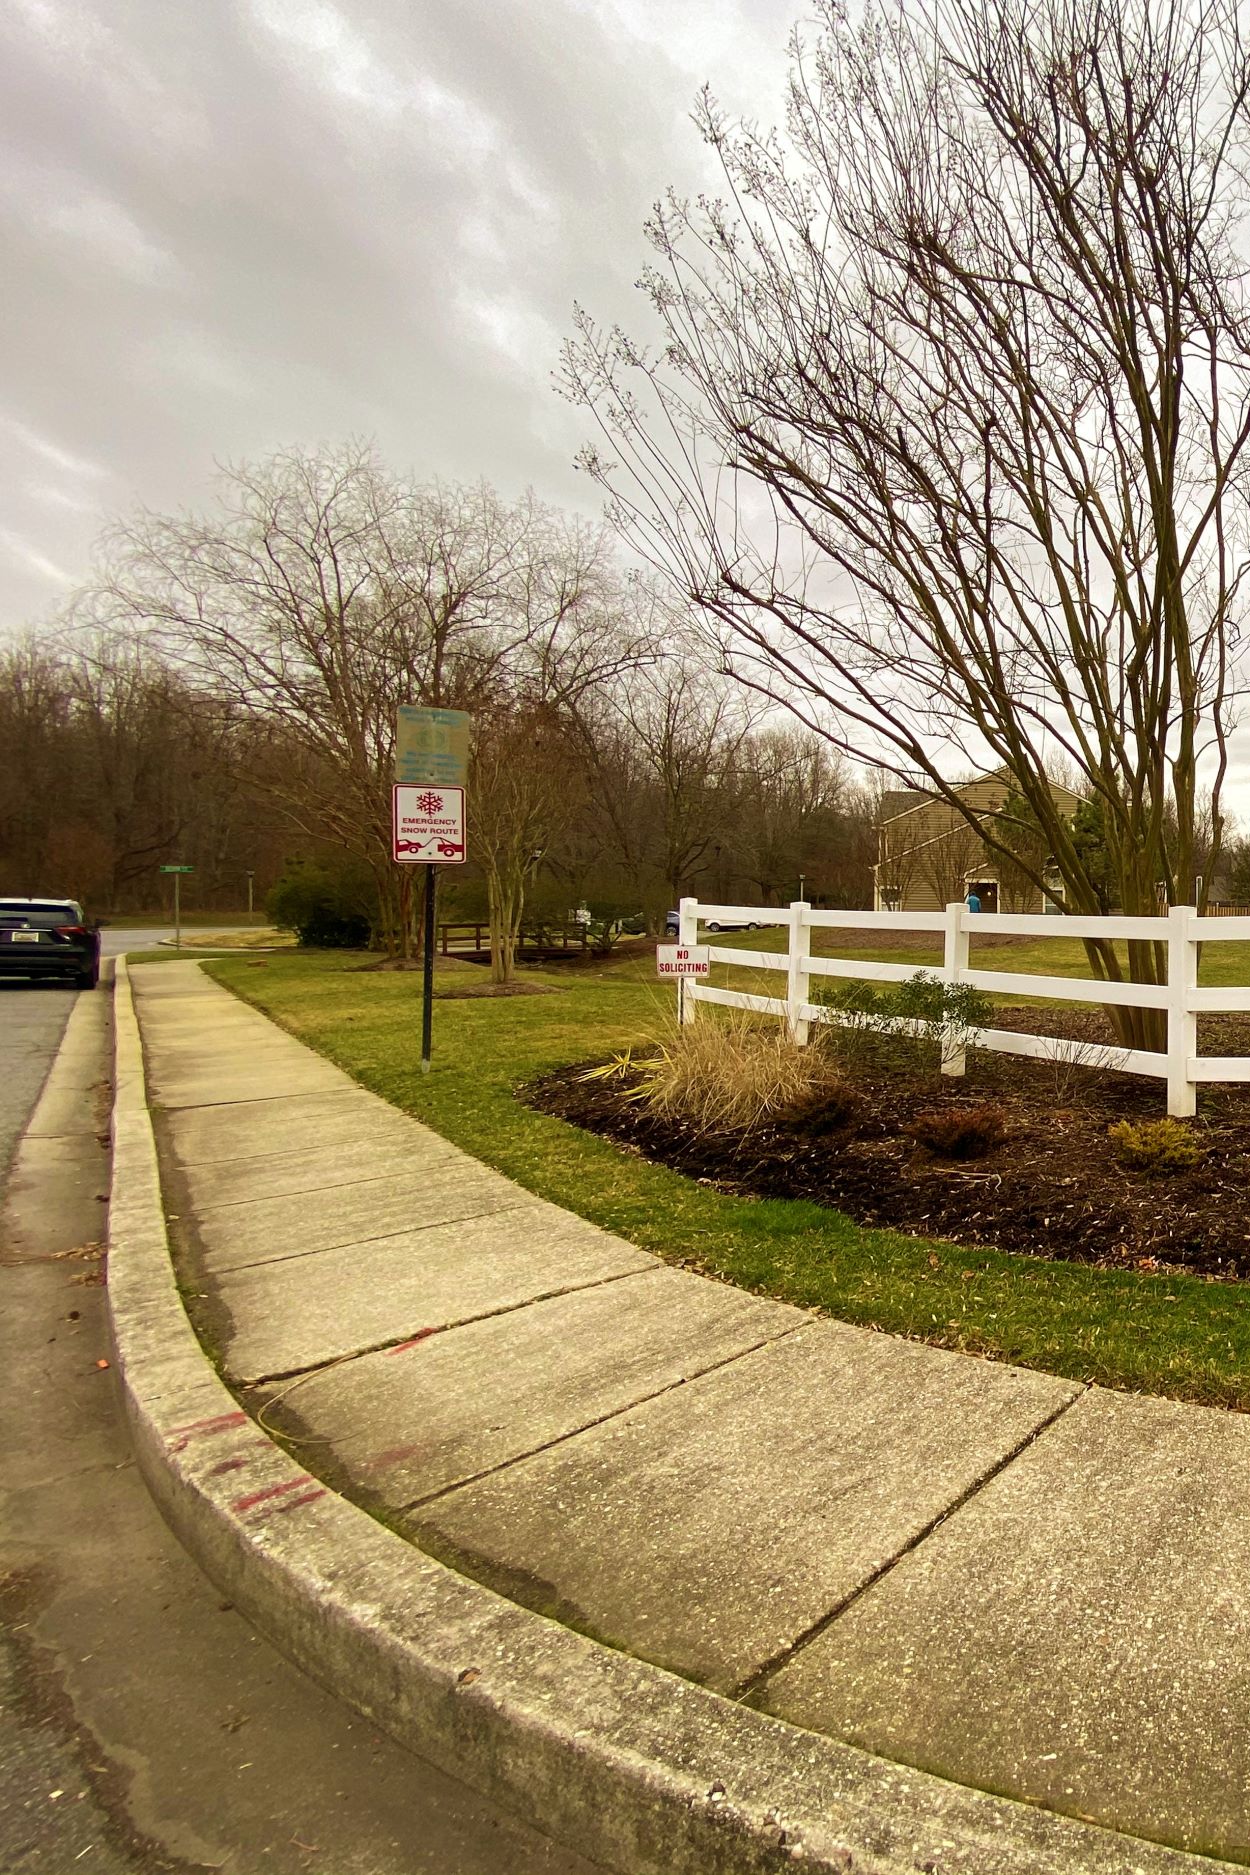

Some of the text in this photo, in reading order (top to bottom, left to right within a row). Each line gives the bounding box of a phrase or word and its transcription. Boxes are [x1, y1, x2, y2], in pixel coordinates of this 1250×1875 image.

[402, 817, 457, 826] EMERGENCY
[401, 826, 459, 836] SNOW ROUTE
[677, 950, 689, 960] NO
[659, 963, 708, 973] SOLICITING
